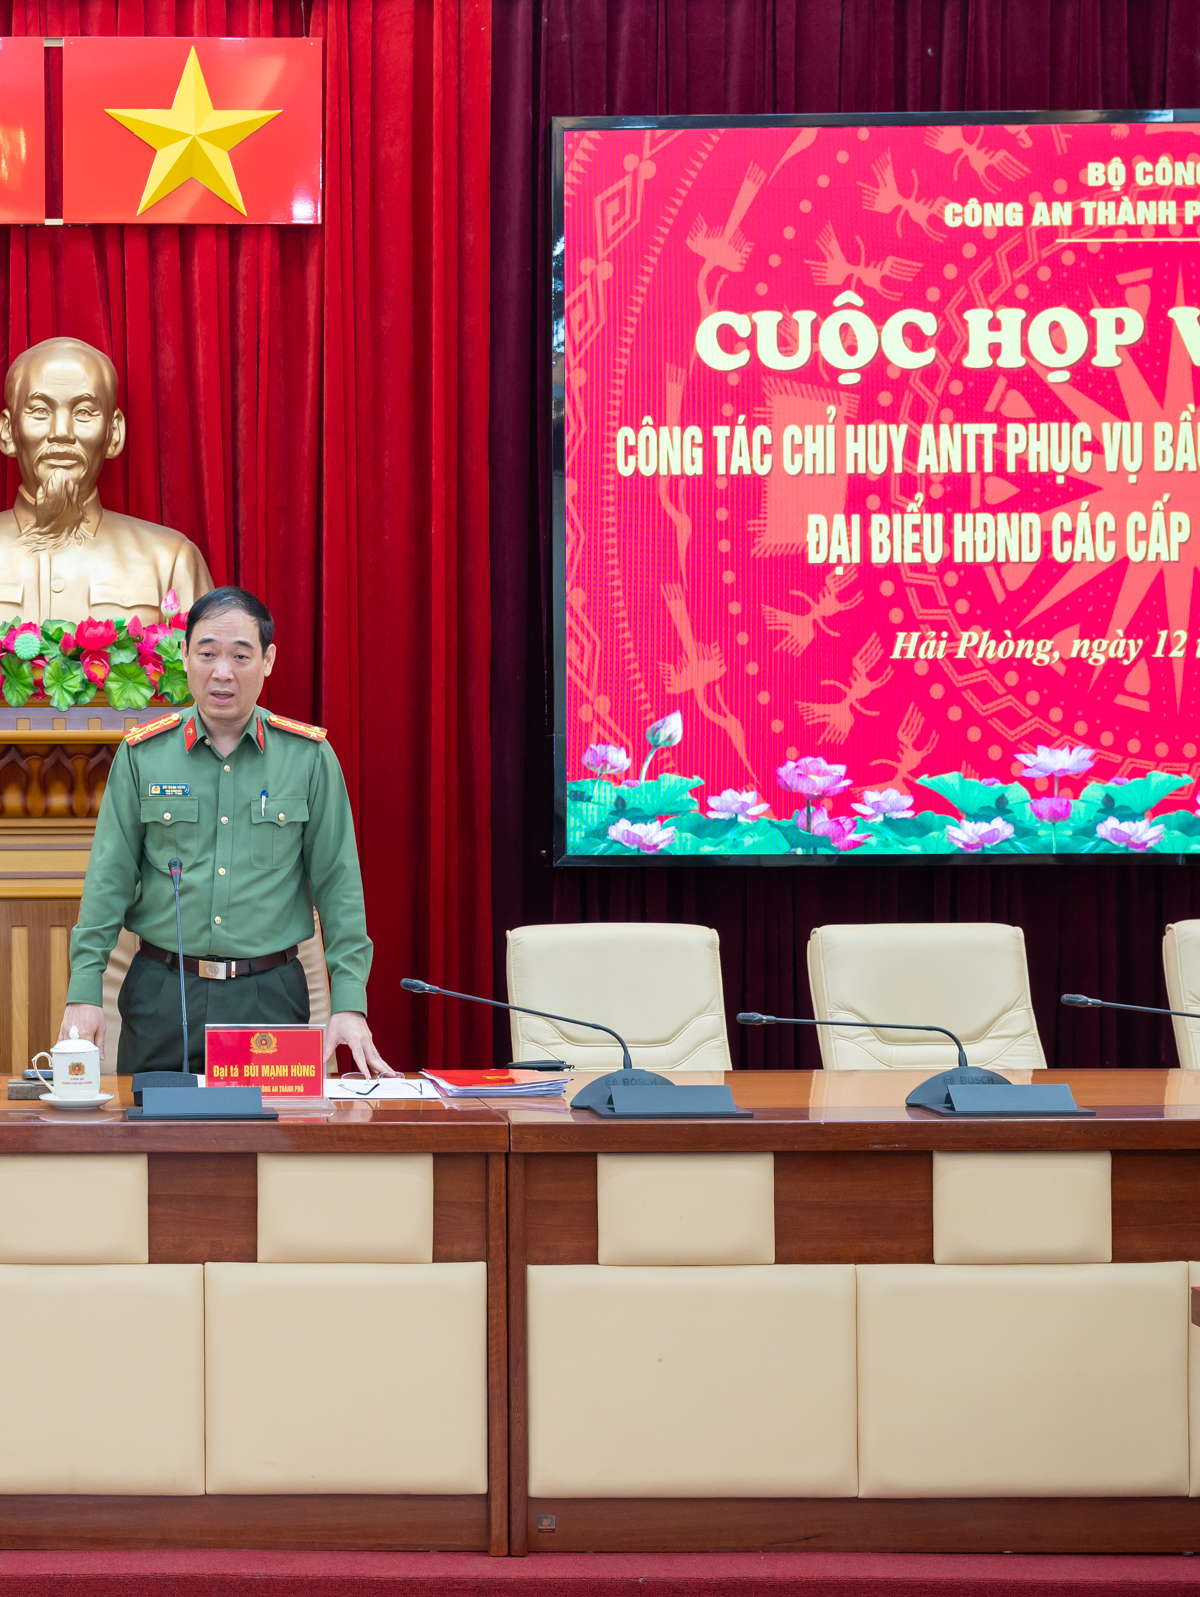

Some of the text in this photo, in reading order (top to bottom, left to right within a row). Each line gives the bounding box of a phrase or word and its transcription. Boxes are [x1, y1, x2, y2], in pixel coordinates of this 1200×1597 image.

[1087, 156, 1200, 191] BỘ CÔN
[944, 198, 1024, 227] CÔNG
[1031, 202, 1072, 226] AN
[1080, 196, 1177, 225] THÀNH
[695, 290, 938, 385] CUỘC
[962, 306, 1145, 383] HỌP
[616, 403, 1200, 484] CÔNG TÁC CHỈ HUY ANTT PHỤC VỤ BẦ
[806, 492, 1191, 576] ĐẠI BIỂU HĐND CÁC CẤP
[890, 631, 949, 659] Hải
[954, 630, 1060, 666] Phòng,
[1070, 629, 1144, 665] ngày
[1151, 629, 1188, 658] 12
[213, 1062, 316, 1080] Đại tá BÙI MẠNH HÙNG
[622, 1077, 657, 1086] BOSCH
[960, 1075, 994, 1085] BOSCH
